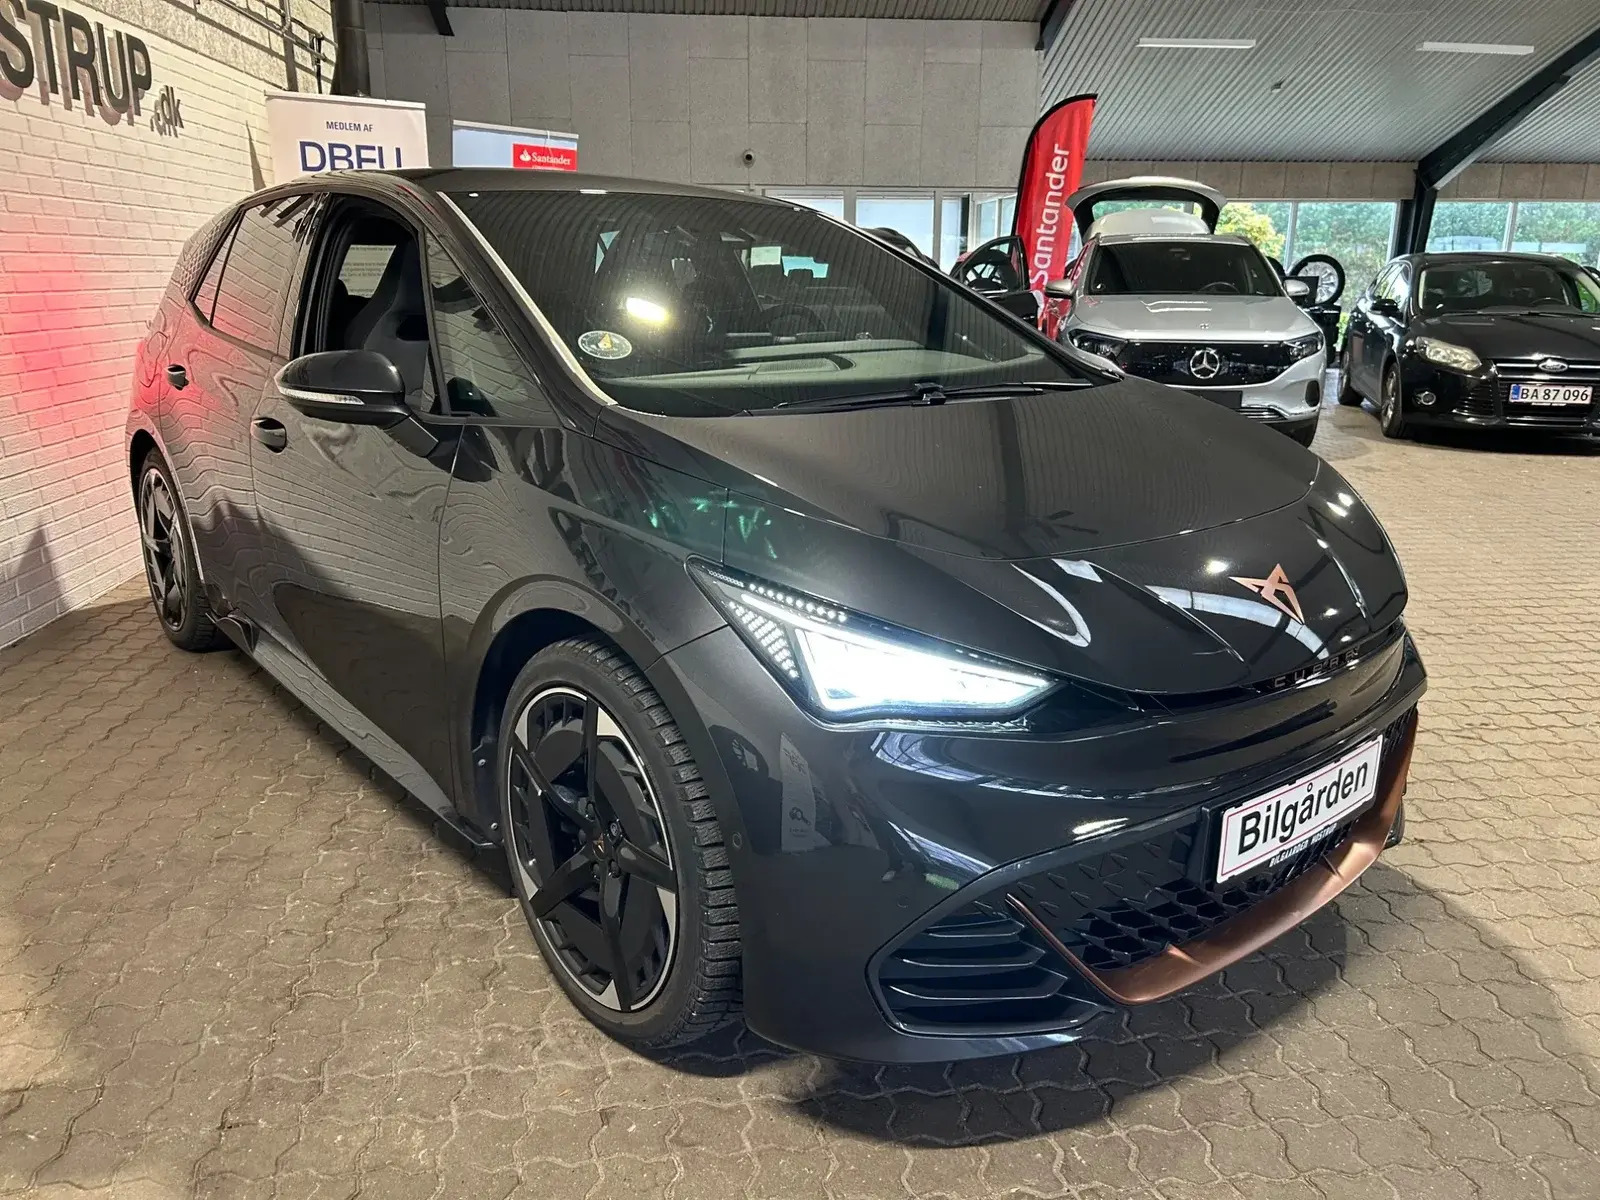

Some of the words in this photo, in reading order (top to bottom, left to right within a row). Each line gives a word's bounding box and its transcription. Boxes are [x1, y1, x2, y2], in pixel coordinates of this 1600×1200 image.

[326, 121, 361, 132] MEDLEM
[363, 124, 373, 132] AF
[531, 152, 571, 165] Santander
[1029, 143, 1070, 287] Santander
[1520, 388, 1539, 400] BA
[1542, 388, 1560, 401] 87
[1563, 389, 1589, 402] 096
[1274, 650, 1358, 688] CUPRA
[1238, 761, 1368, 855] Bilgården
